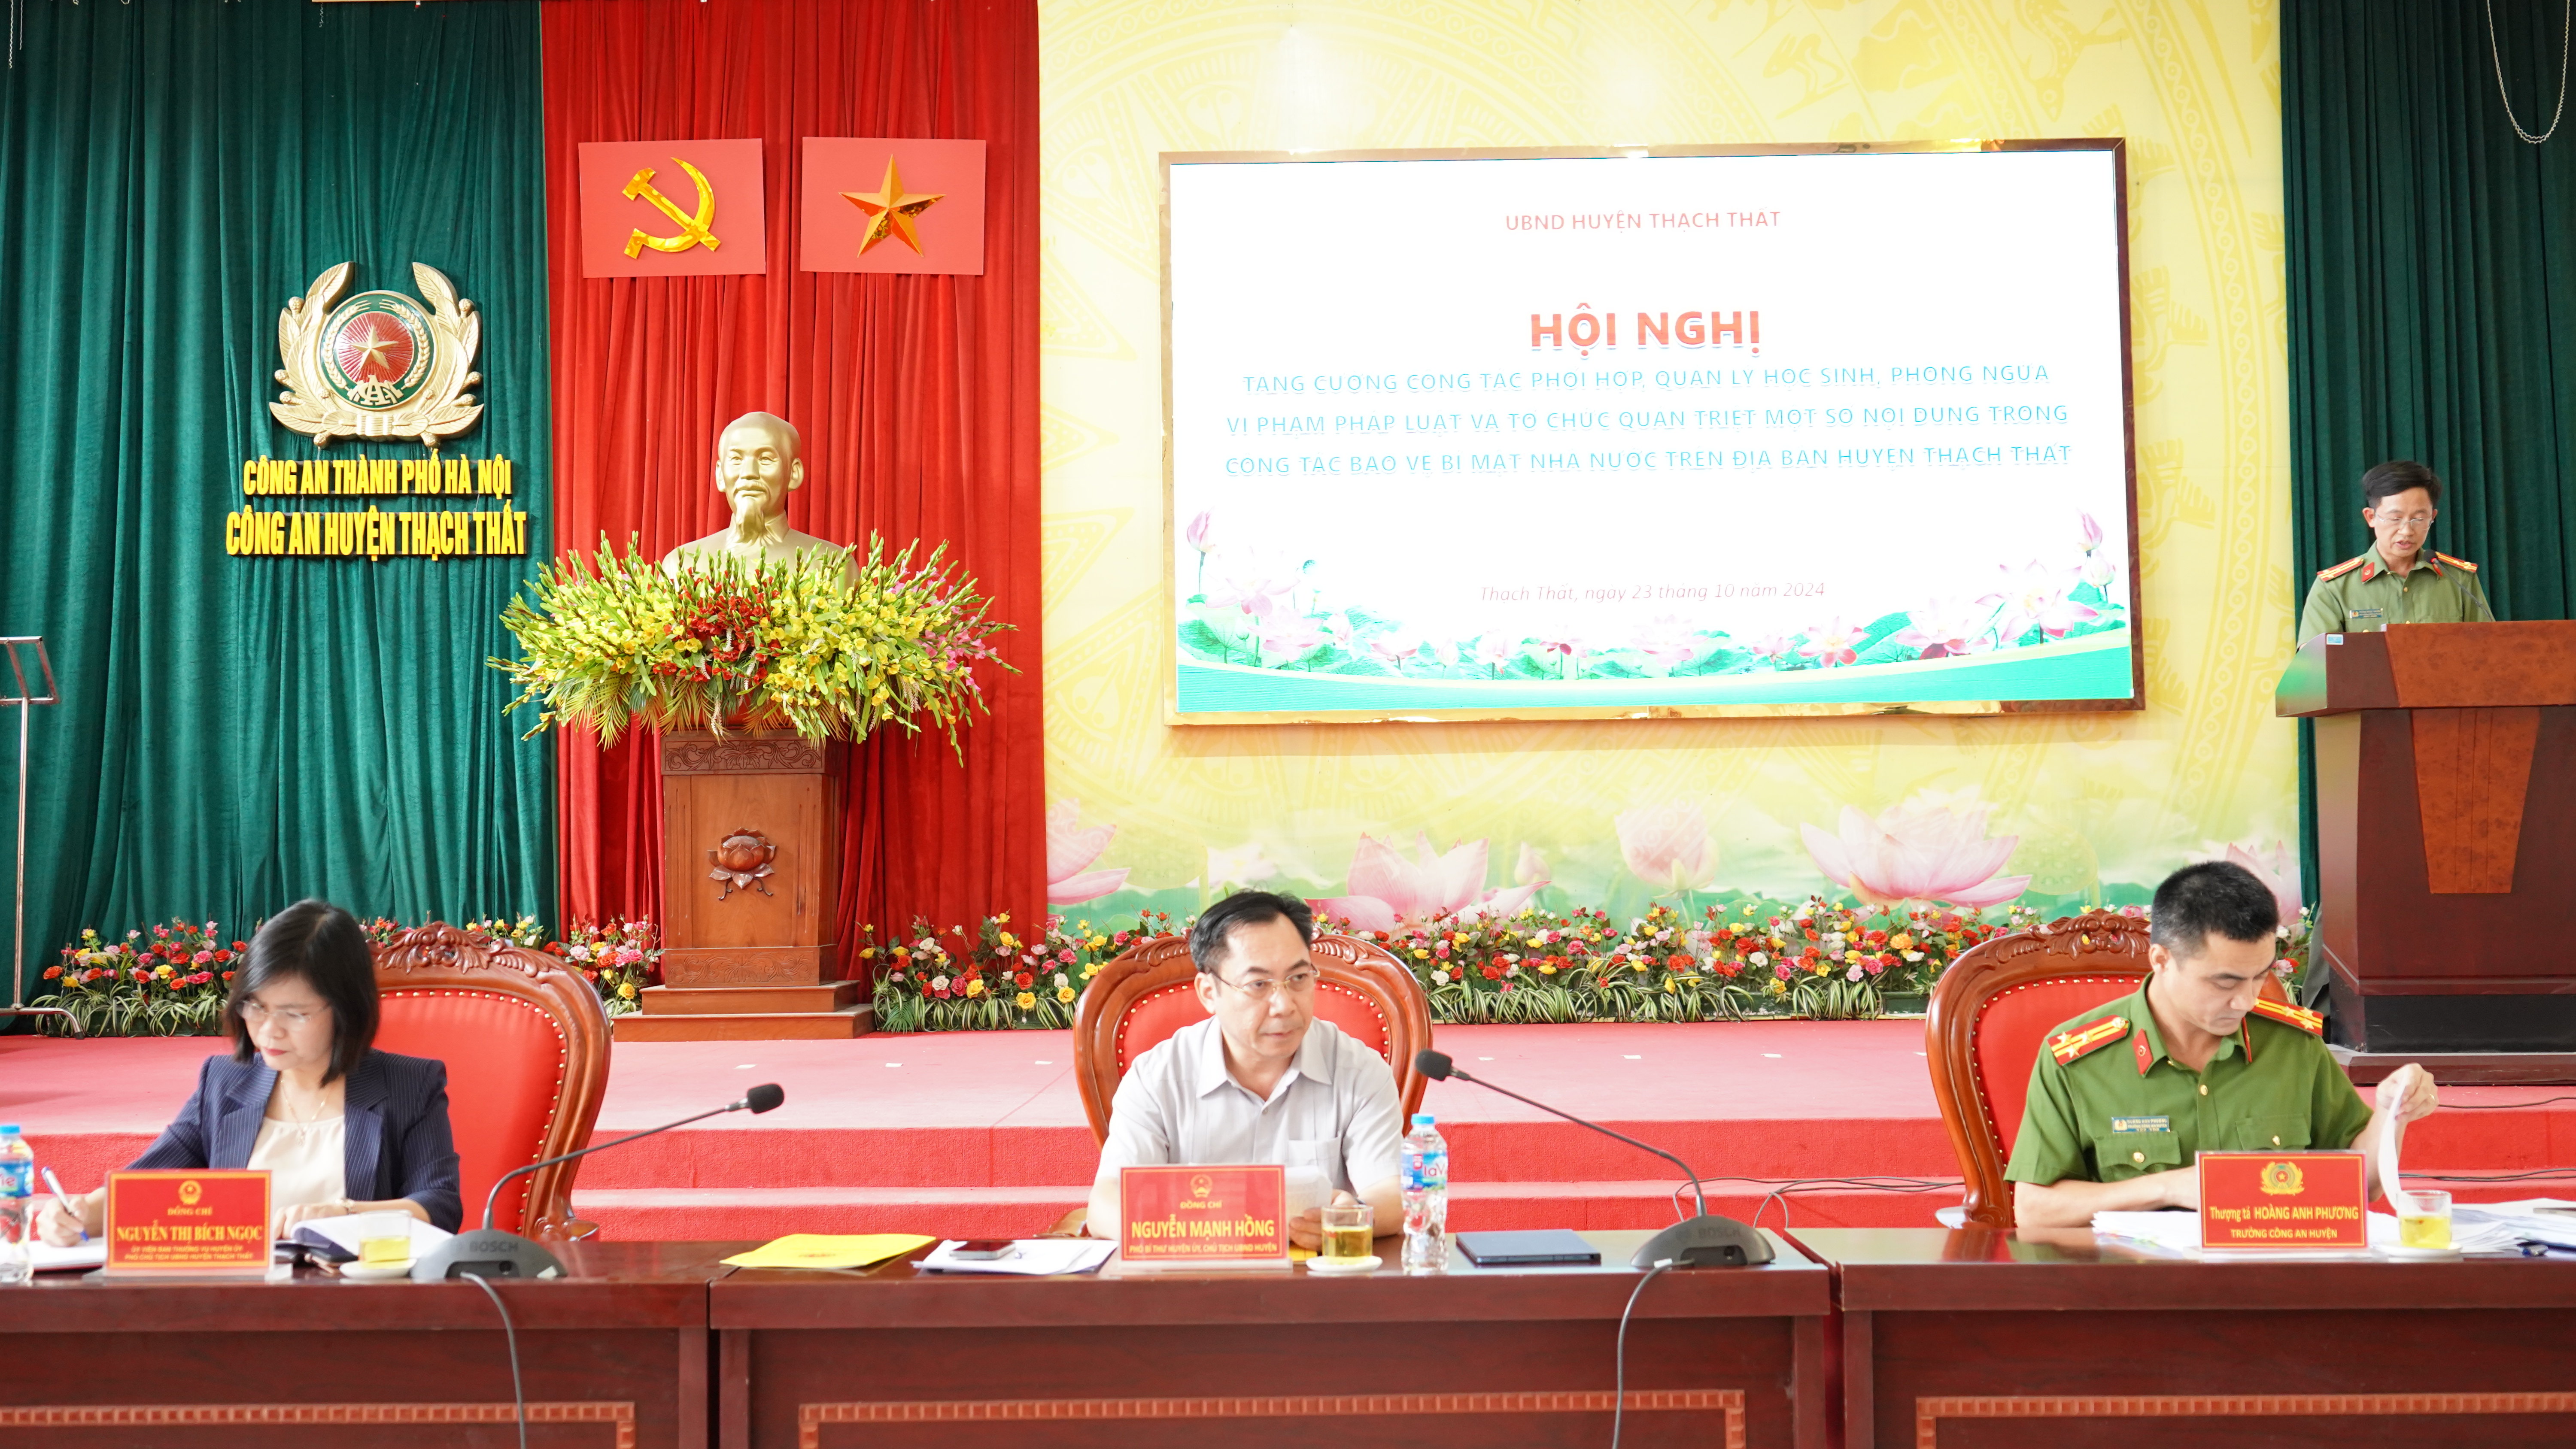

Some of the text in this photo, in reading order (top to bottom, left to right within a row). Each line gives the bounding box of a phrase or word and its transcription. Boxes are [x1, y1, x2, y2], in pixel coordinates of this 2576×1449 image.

[1506, 207, 1780, 233] UBND HUYỆN THẠCH THẤT
[1531, 302, 1759, 358] HỘI NGHỊ
[1821, 367, 1880, 385] SINH,
[1915, 407, 1978, 422] DUNG
[1990, 405, 2067, 421] TRONG
[243, 448, 511, 499] CÔNG AN THÀNH PHỐ HÀ NỘI
[226, 499, 526, 561] CÔNG AN HUYỆN THẠCH THẤT
[1480, 582, 1825, 603] Thạch Thất, ngày 23 tháng 10 năm 2024
[195, 1206, 213, 1216] CHÍ
[1180, 1199, 1222, 1209] ĐỒNG CHÍ
[2210, 1203, 2359, 1222] Thượng tá HOÀNG ANH PHƯƠNG
[116, 1219, 262, 1244] NGUYỄN THỊ BÍCH NGỌC
[1132, 1214, 1275, 1240] NGUYỄN MẠNH HỒNG
[2231, 1227, 2337, 1240] TRƯỞNG CÔNG AN HUYỆN
[469, 1241, 518, 1252] BOSCH
